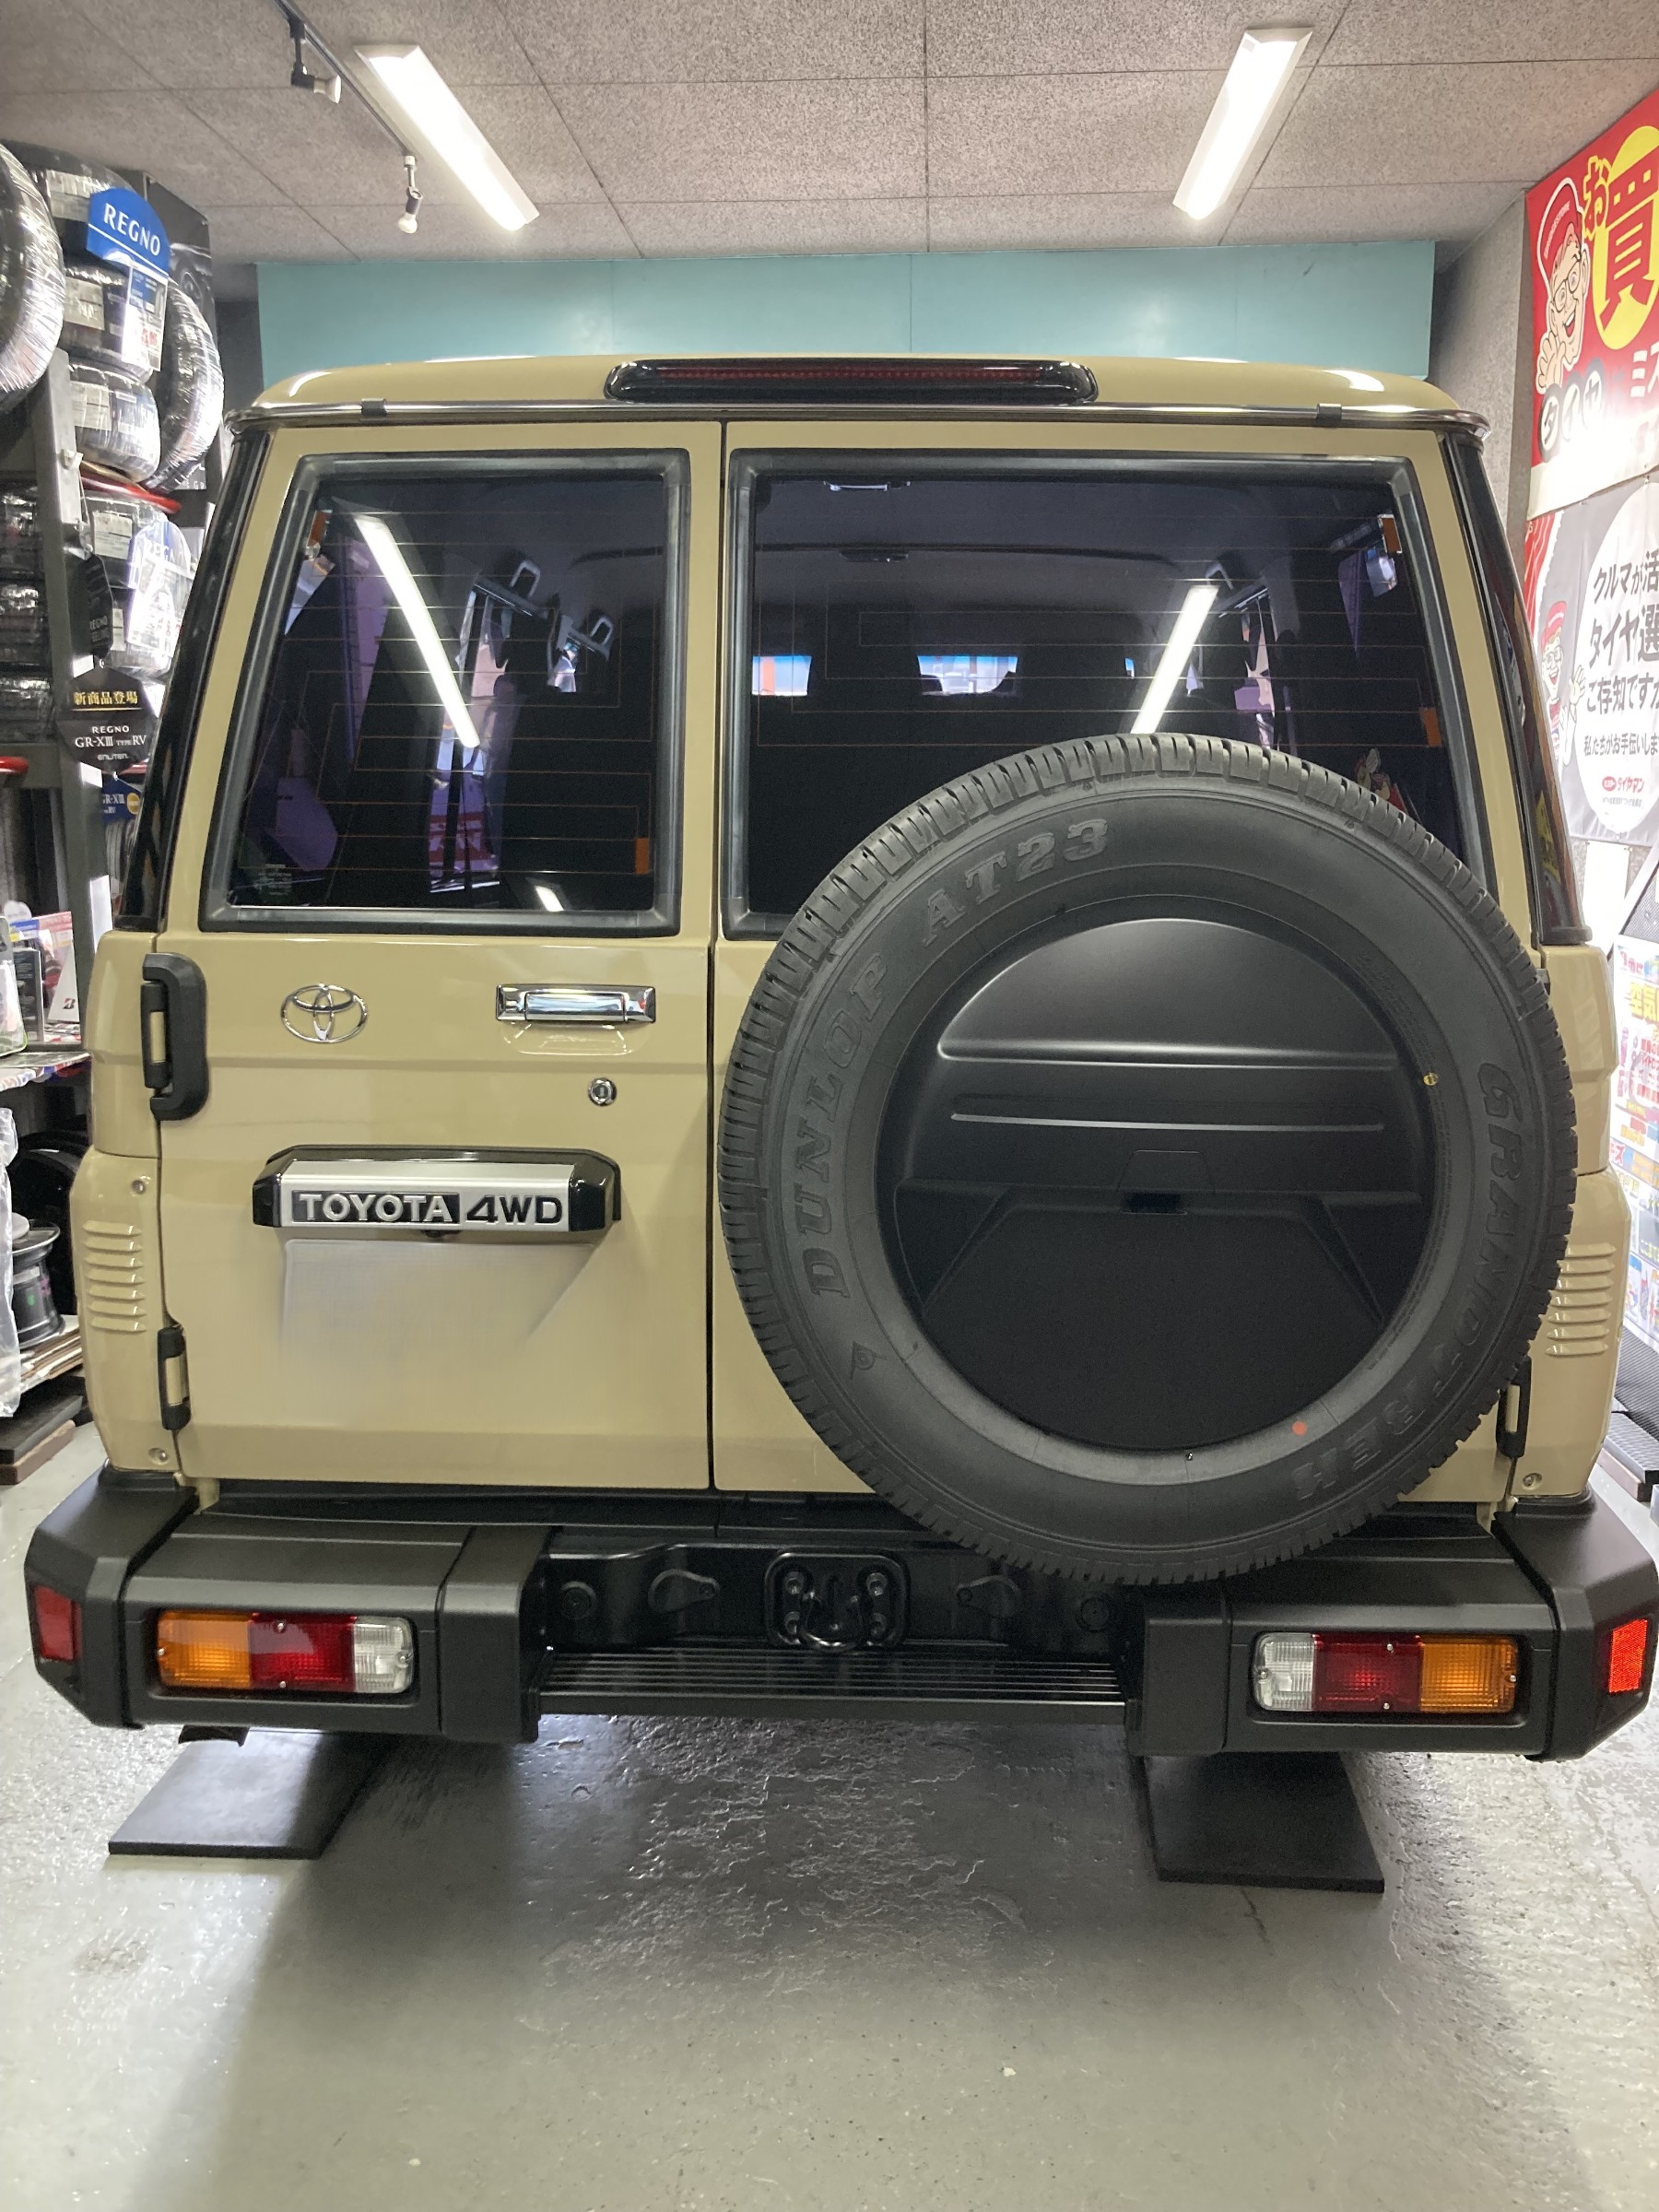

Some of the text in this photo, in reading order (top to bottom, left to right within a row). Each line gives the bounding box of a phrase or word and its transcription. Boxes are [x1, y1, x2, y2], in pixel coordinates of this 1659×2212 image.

[103, 202, 161, 257] REGNO
[73, 691, 138, 705] 新商品登場
[91, 725, 130, 734] REGNO
[132, 735, 147, 746] RV
[1583, 732, 1659, 757] 私たちがお手伝いしま
[1618, 776, 1645, 794] タイヤマン
[923, 818, 1108, 947] AT23
[795, 952, 889, 1299] DUNLOP
[300, 1193, 564, 1226] TOYOTA 4WD
[1294, 1062, 1524, 1502] GRANDTREK
